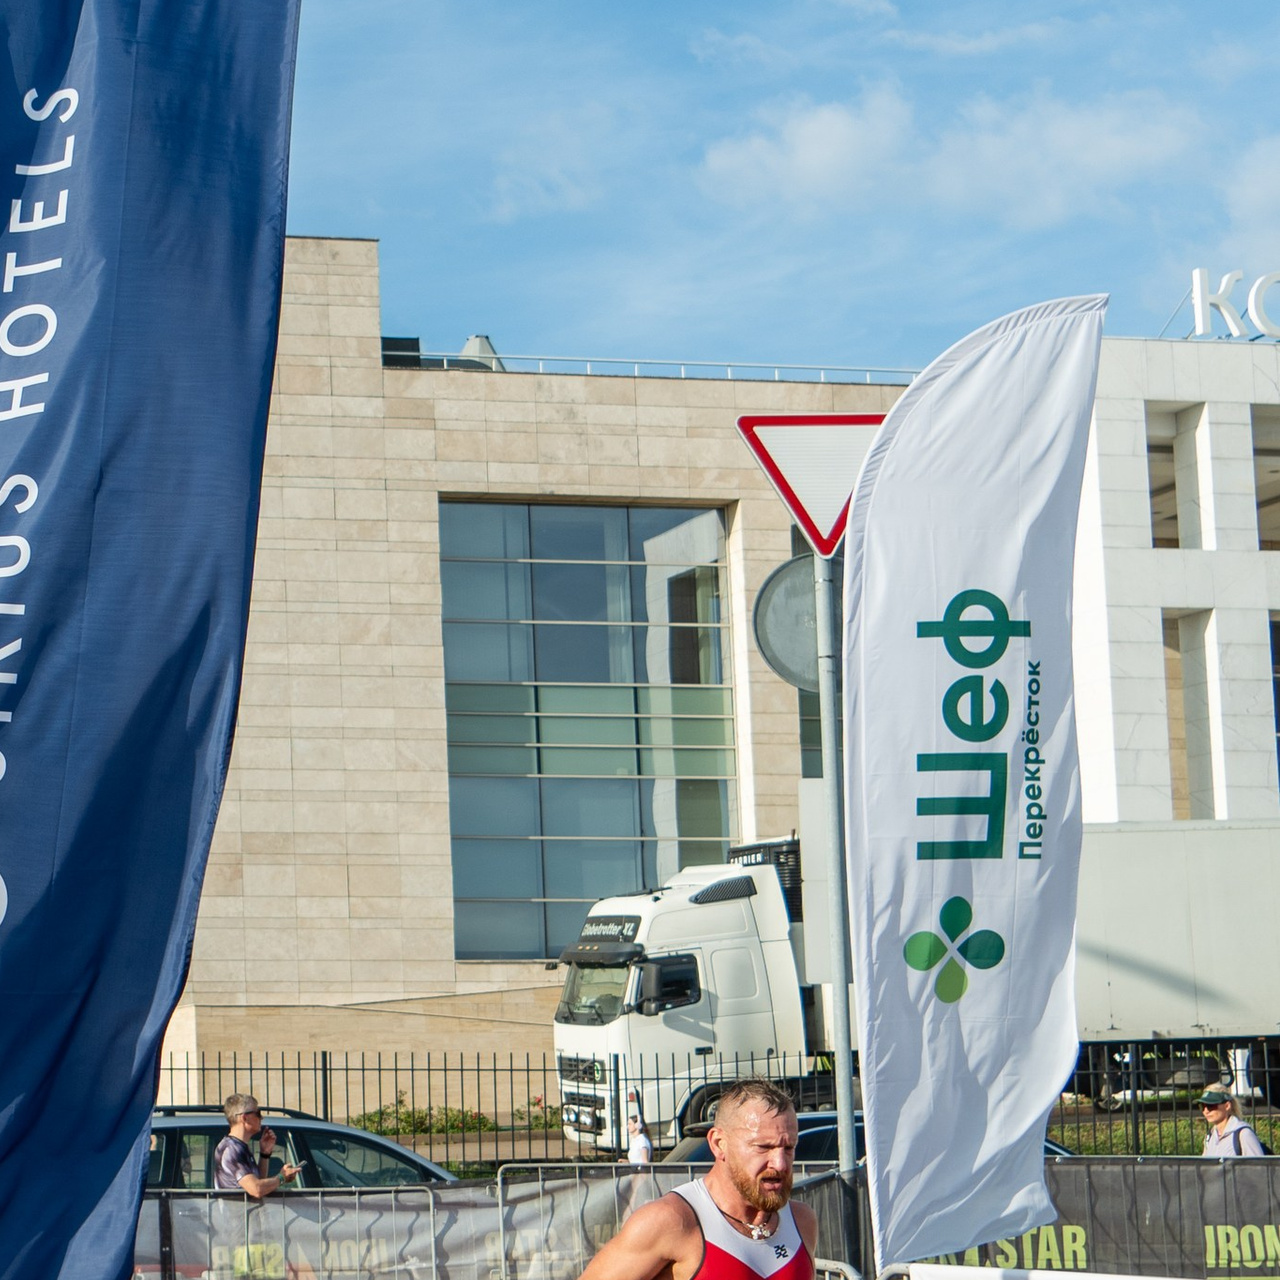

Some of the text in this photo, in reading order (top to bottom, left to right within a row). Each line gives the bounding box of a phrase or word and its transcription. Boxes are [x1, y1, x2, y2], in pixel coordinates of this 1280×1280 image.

[916, 588, 1031, 860] Шеф
[1018, 659, 1047, 860] Перекрёсток
[622, 922, 635, 936] XL
[996, 1224, 1088, 1269] STAR
